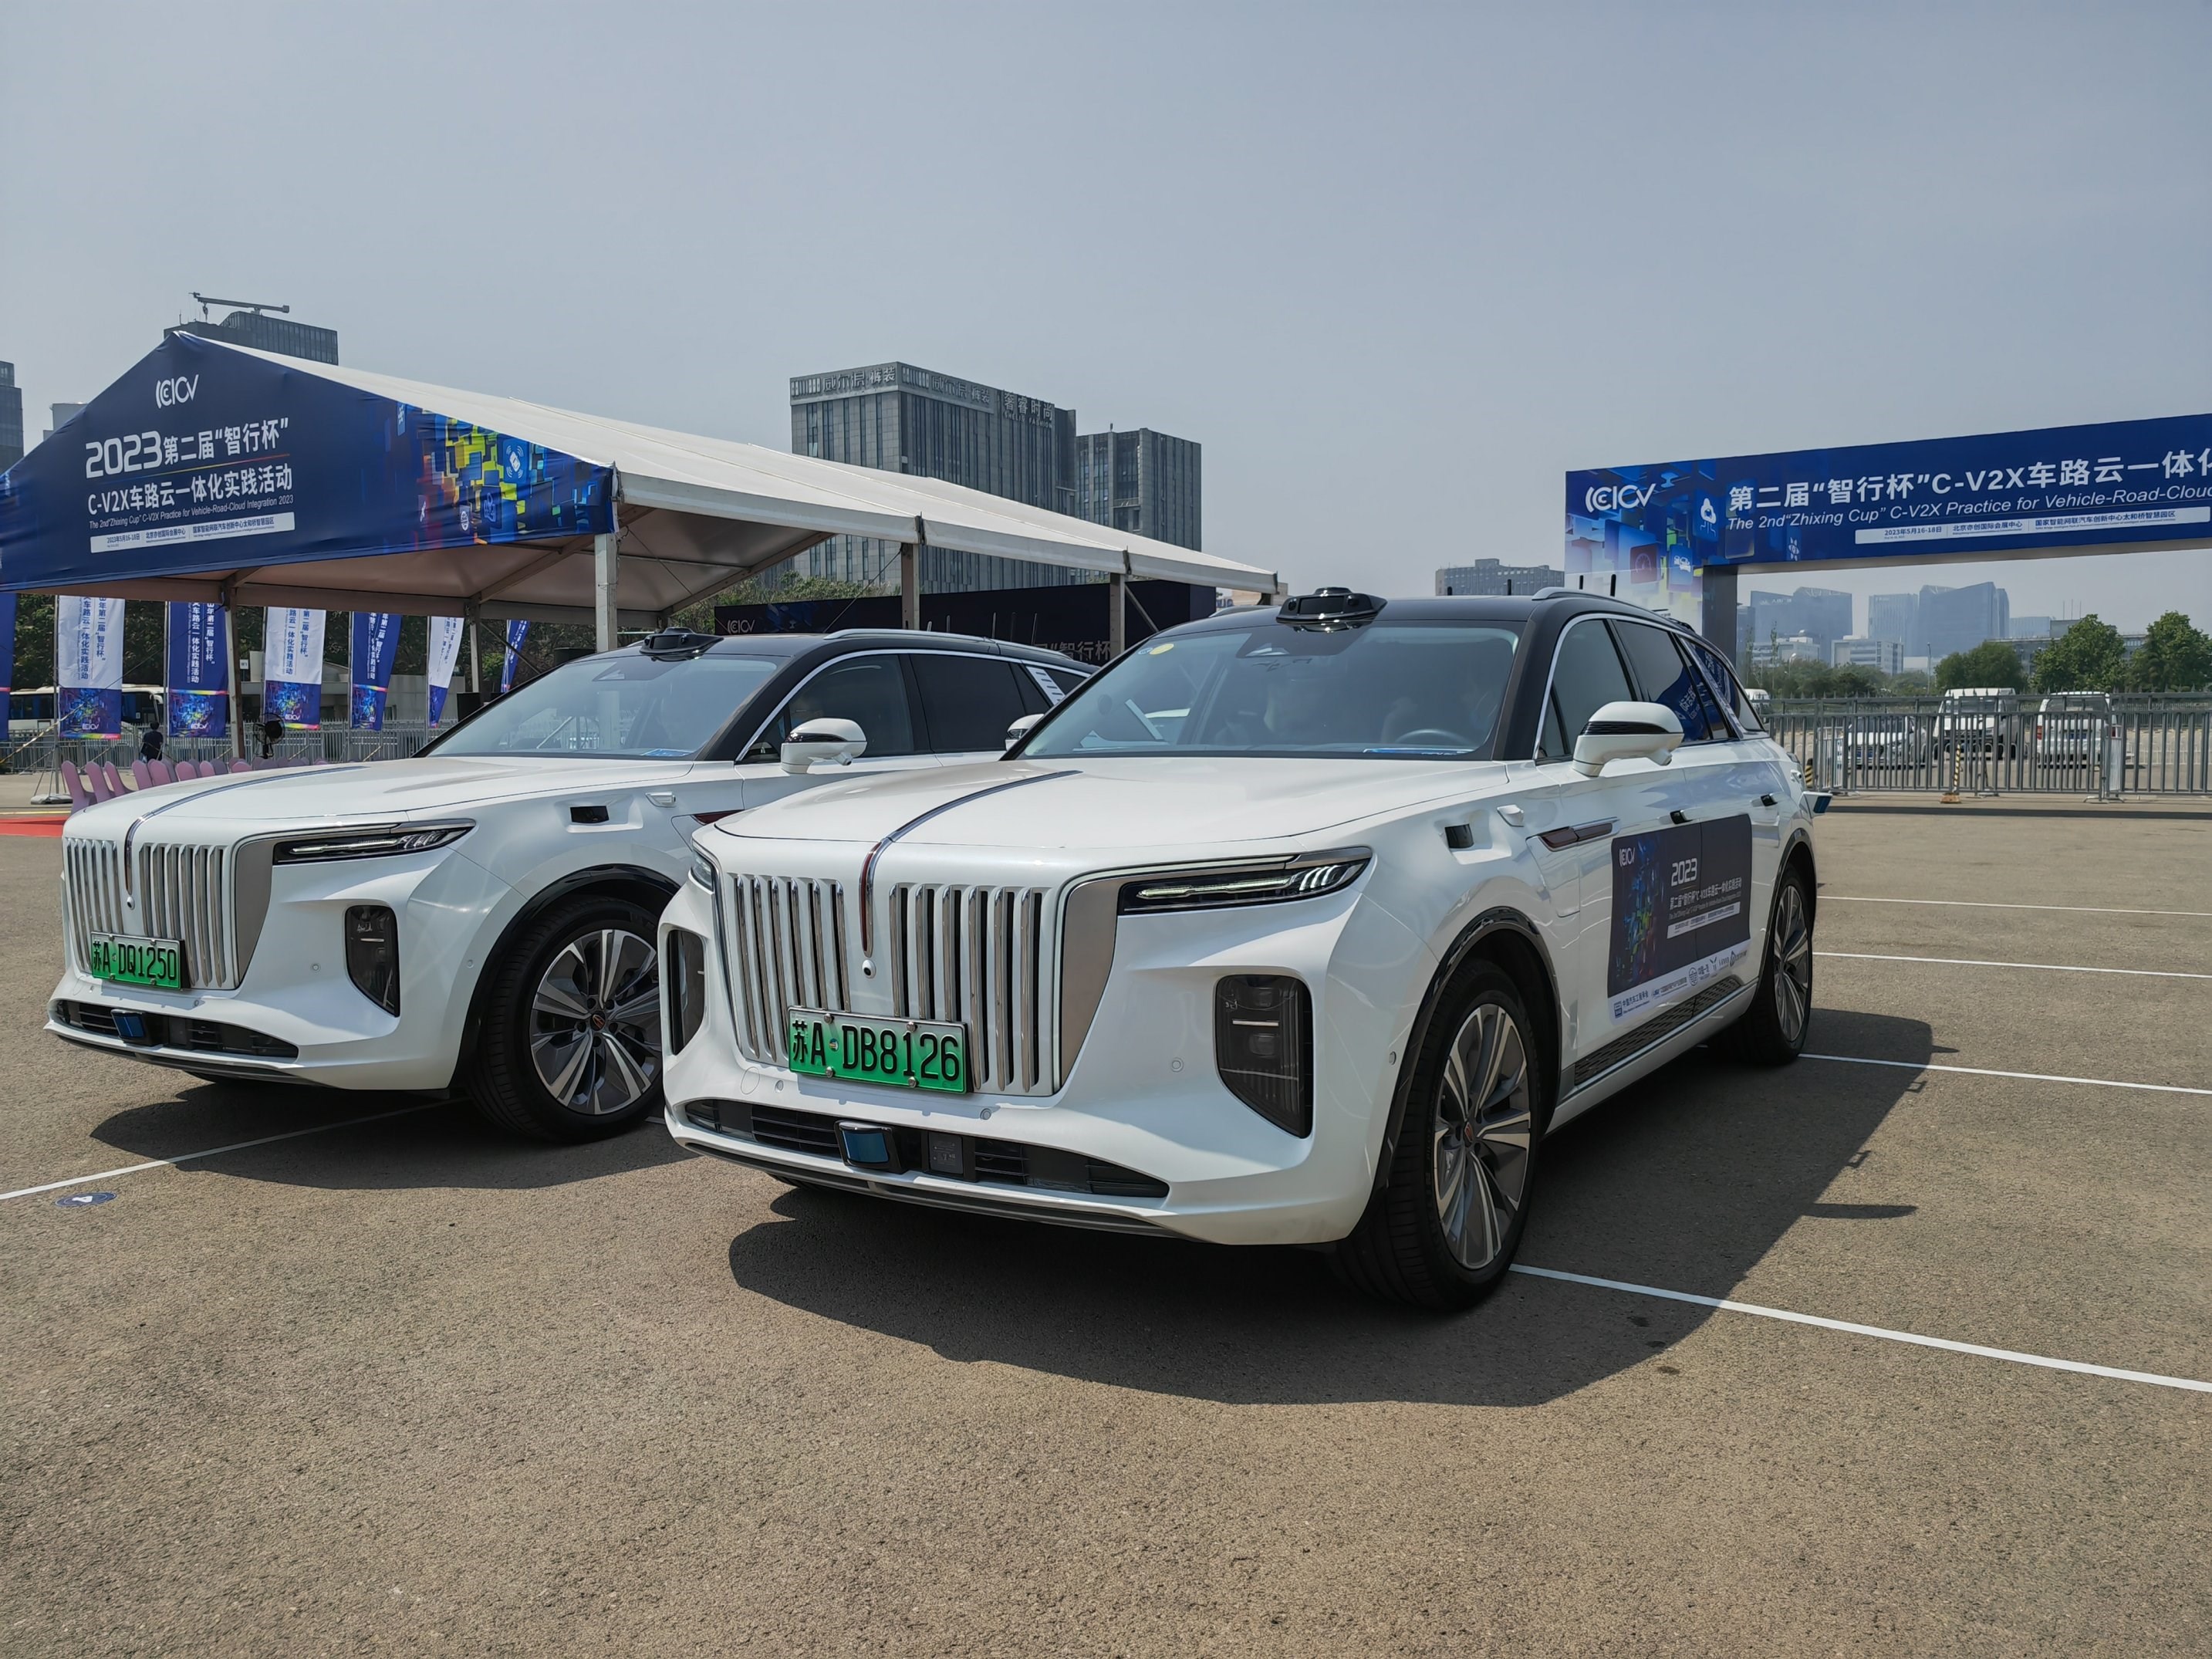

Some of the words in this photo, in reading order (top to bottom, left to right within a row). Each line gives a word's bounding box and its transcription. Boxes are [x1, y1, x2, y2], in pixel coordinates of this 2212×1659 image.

[142, 512, 159, 522] C-V2X
[160, 509, 181, 519] Practice
[191, 501, 245, 516] Vehicle-Road-Cloud
[247, 498, 277, 509] Integration
[279, 495, 293, 505] 2023
[1728, 518, 1753, 530] The
[1890, 503, 1942, 519] C-V2X
[1946, 500, 2011, 515] Practice
[2017, 497, 2040, 510] for
[1885, 526, 1942, 536] 2023年5月16-18日
[1953, 521, 2023, 532] 北京亦创国际会展中心
[1671, 858, 1697, 887] 2023
